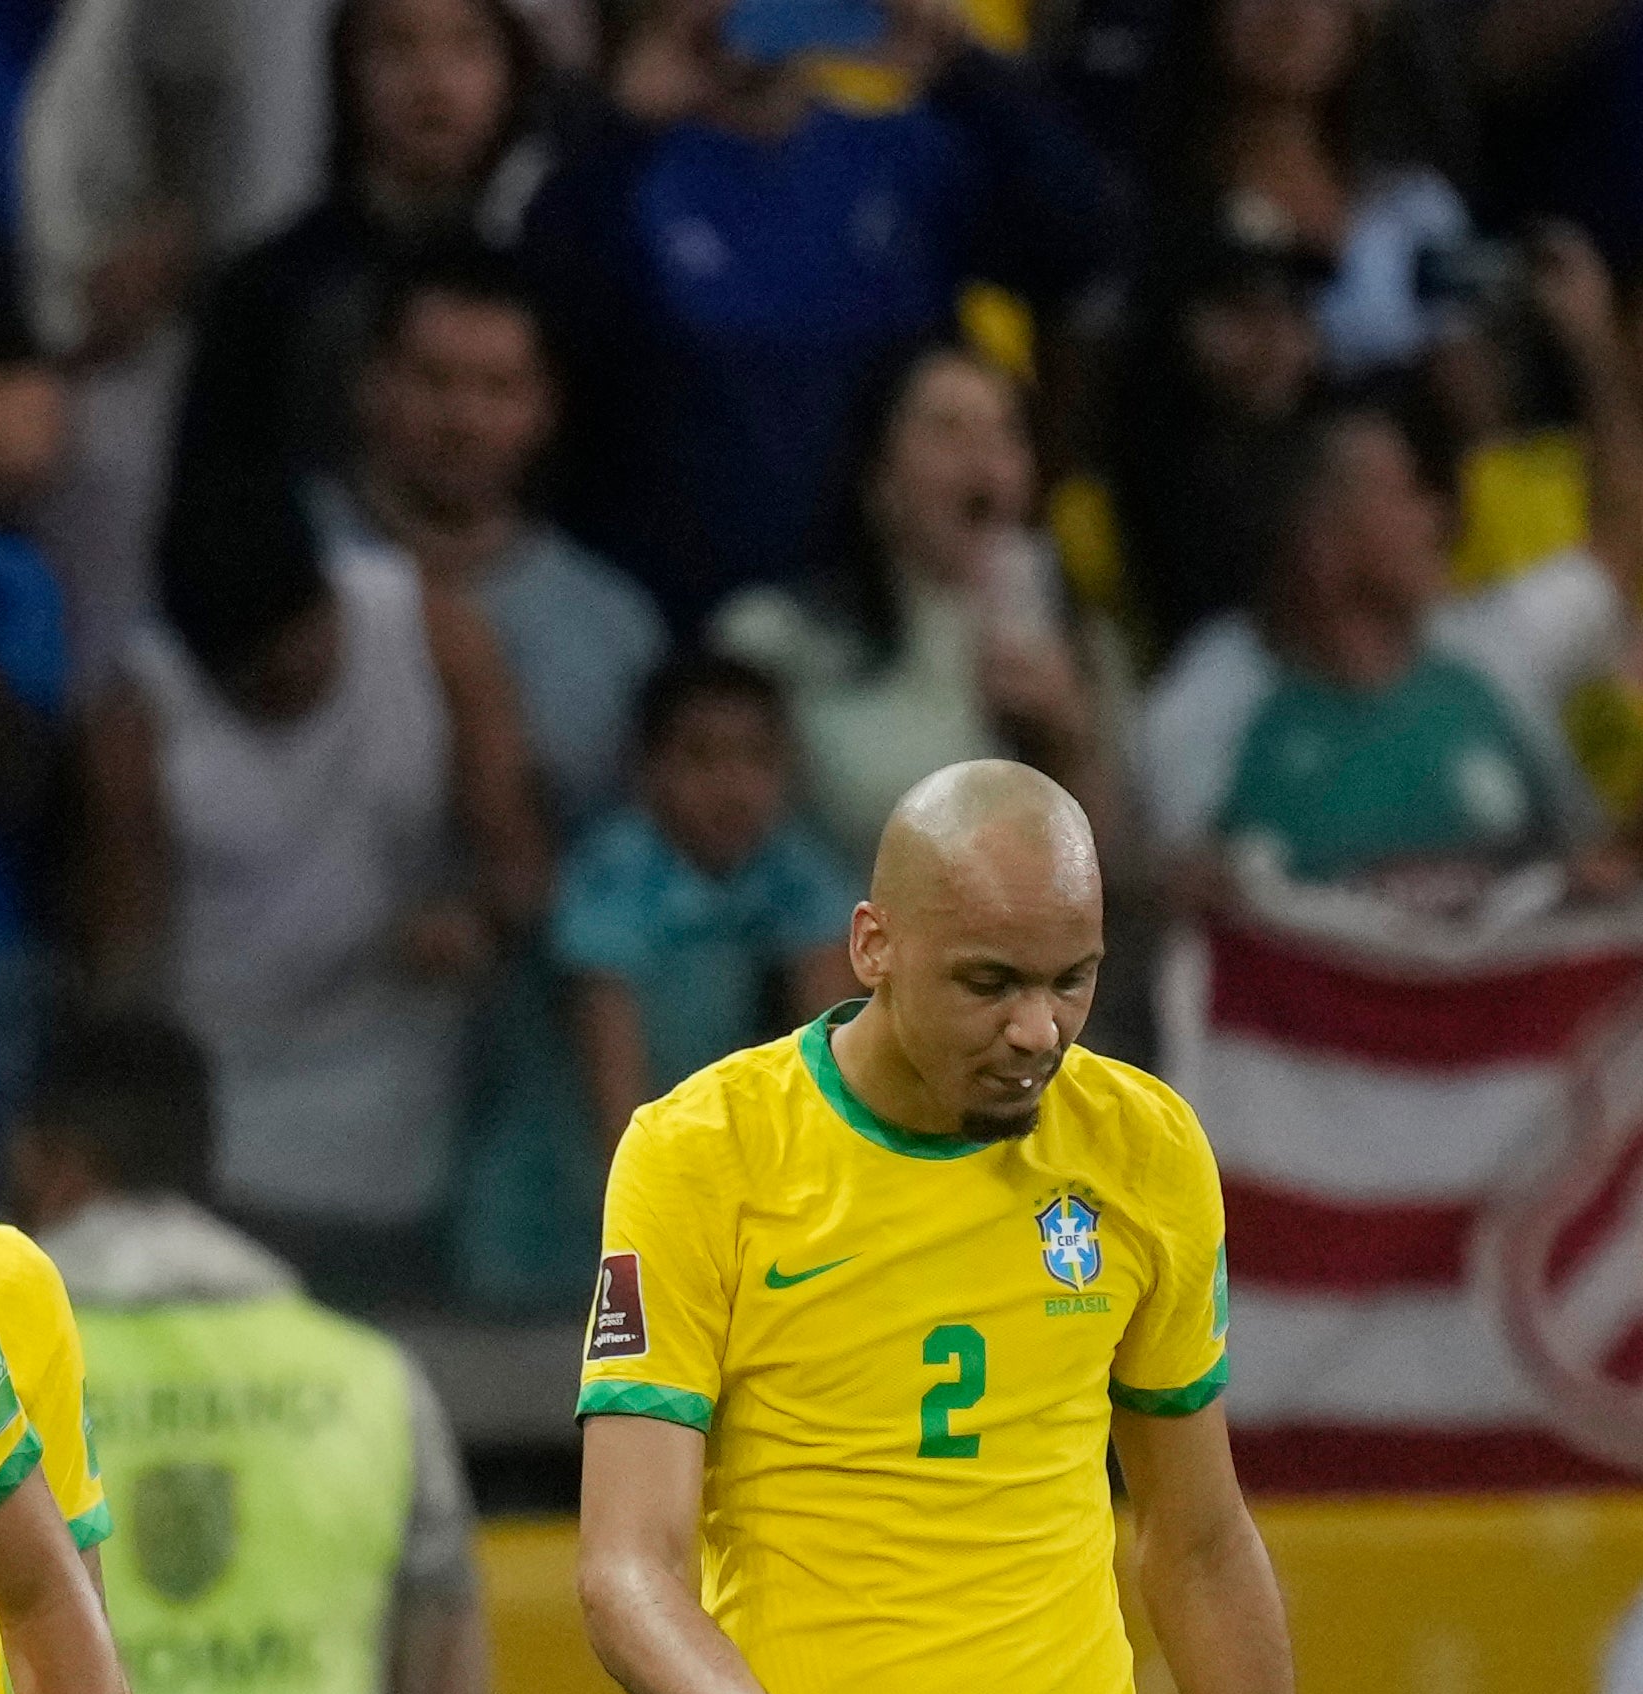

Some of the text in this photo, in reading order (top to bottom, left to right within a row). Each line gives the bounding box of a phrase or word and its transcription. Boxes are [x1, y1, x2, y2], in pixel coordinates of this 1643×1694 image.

[1057, 1234, 1081, 1247] CBF
[1045, 1297, 1111, 1317] BRASIL
[917, 1325, 986, 1459] 2
